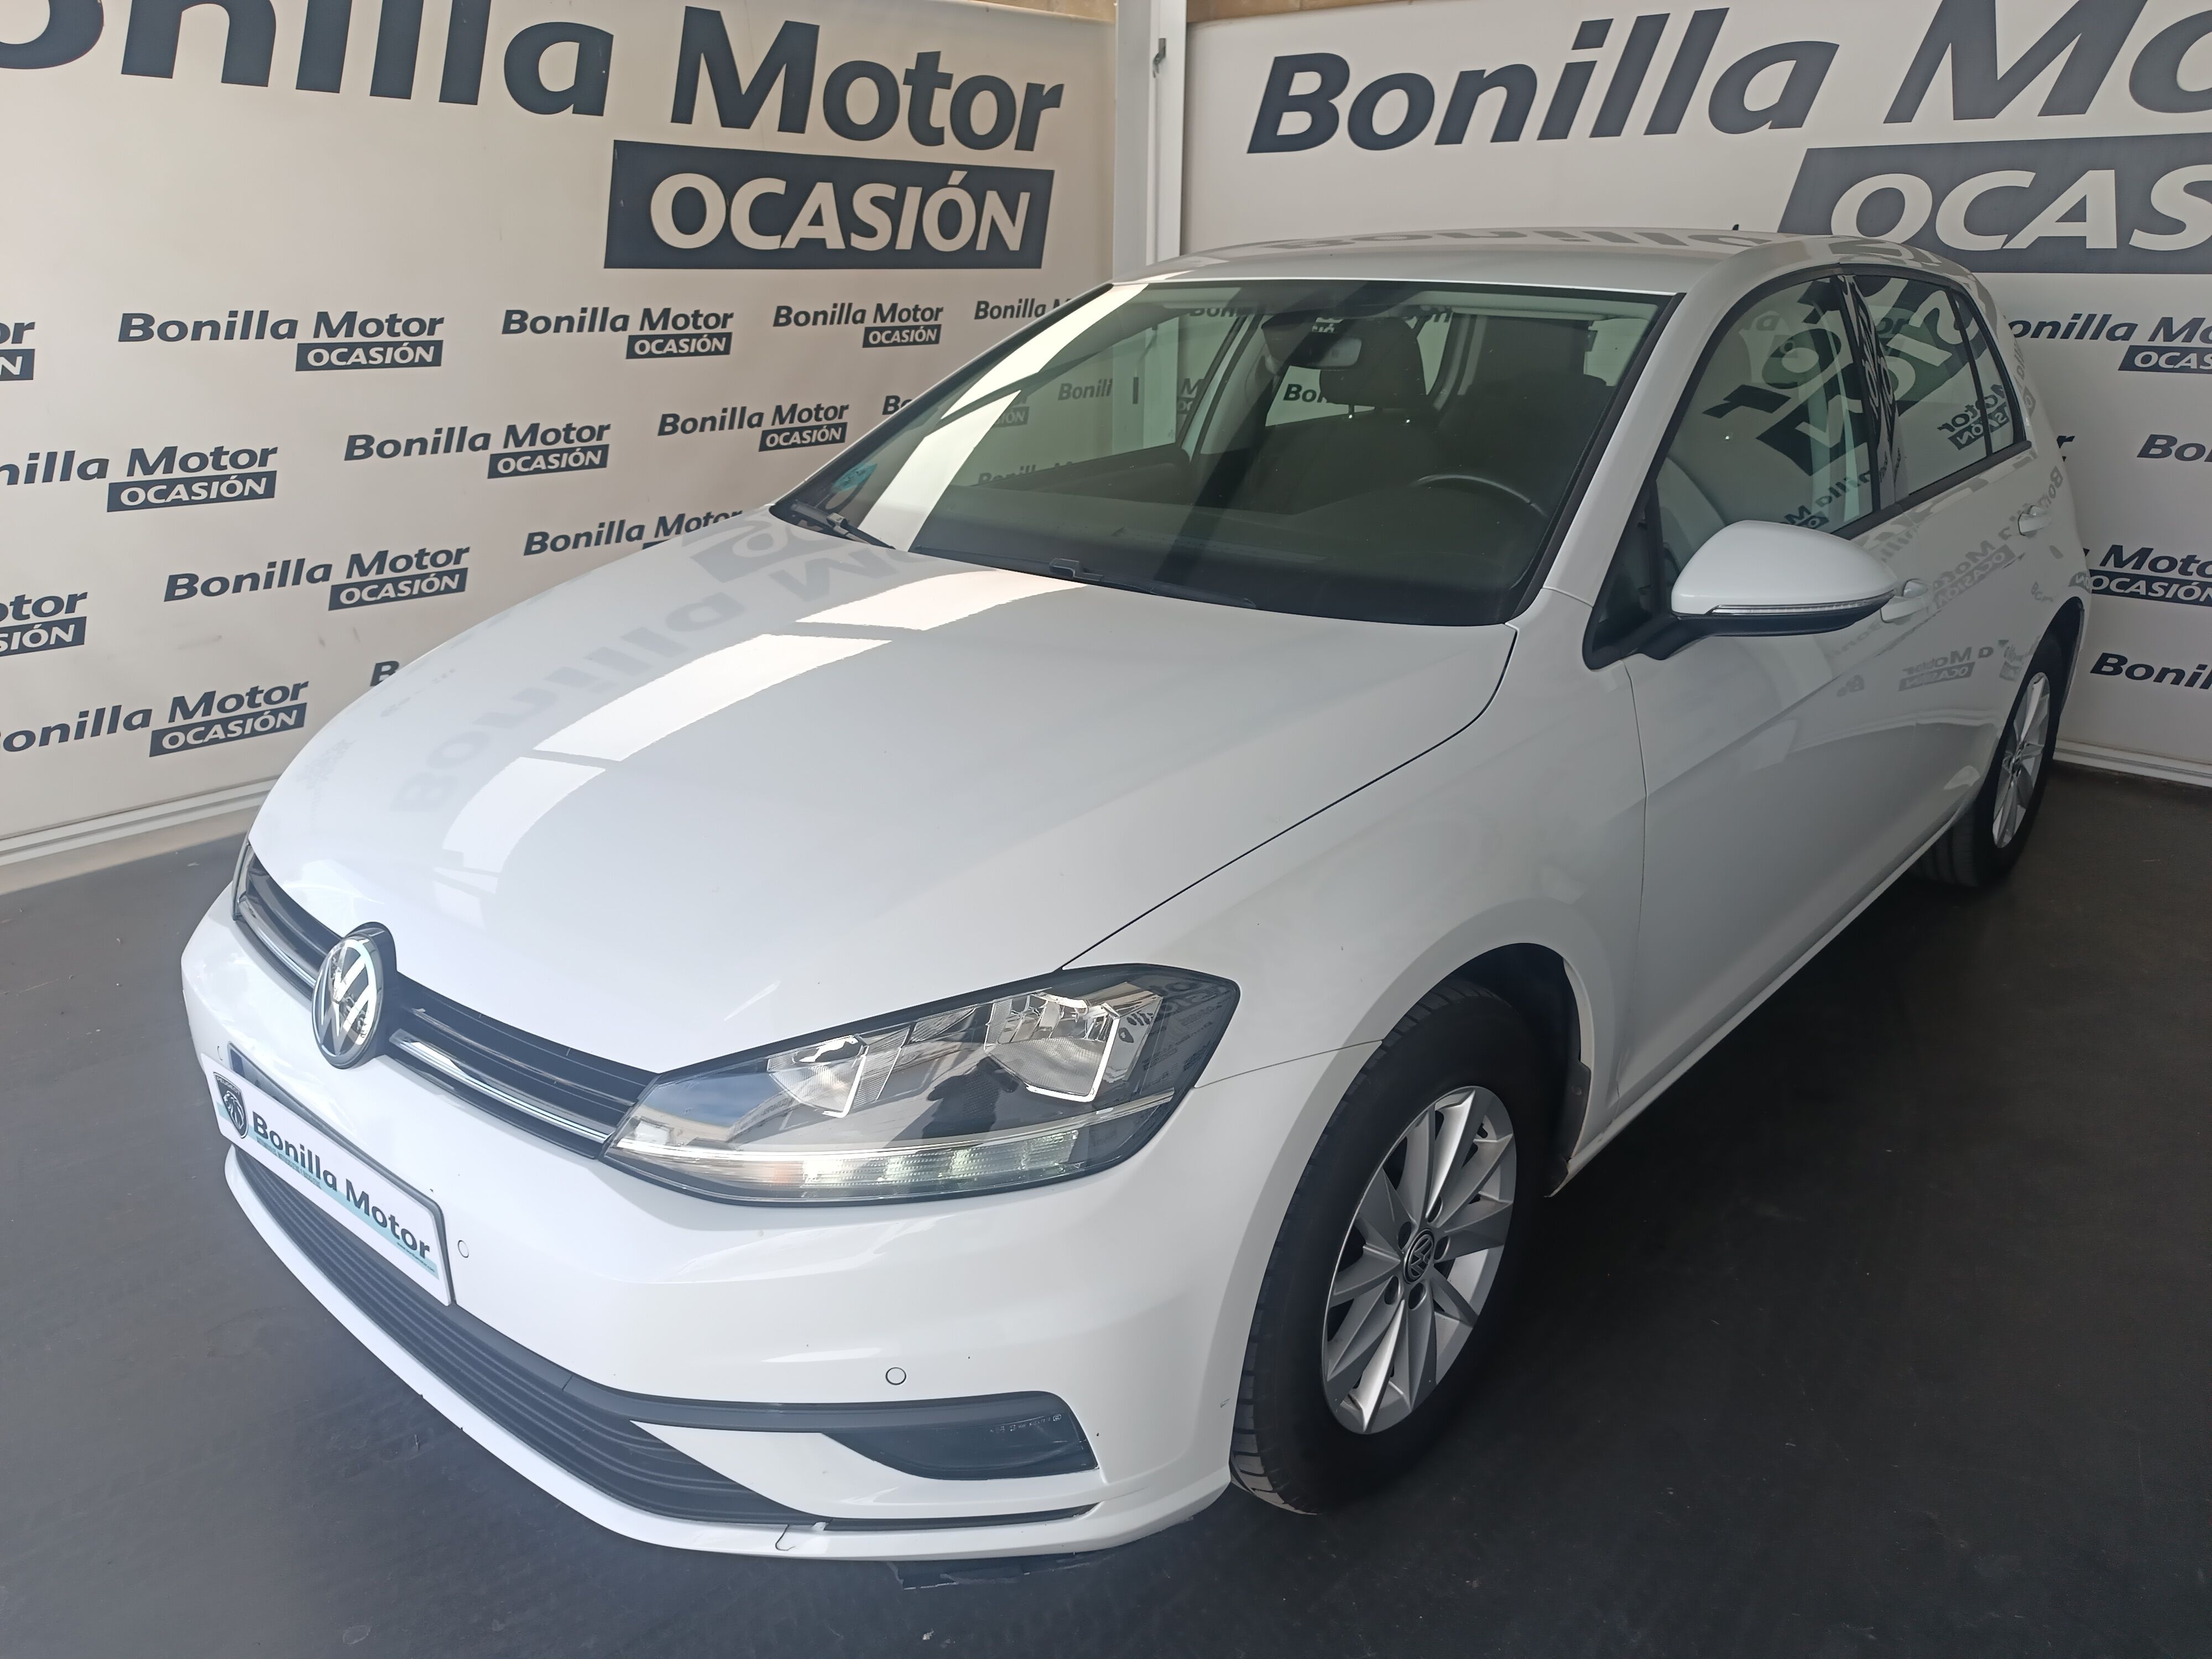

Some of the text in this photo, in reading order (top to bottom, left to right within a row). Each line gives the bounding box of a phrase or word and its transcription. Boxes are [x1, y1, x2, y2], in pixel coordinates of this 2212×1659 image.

[671, 6, 1064, 152] Motor
[1247, 8, 1839, 154] Bonilla
[651, 171, 1030, 252] OCASIÓN
[502, 307, 734, 334] Bonilla Motor
[773, 302, 943, 327] Bonilla Motor
[974, 299, 1046, 320] Bonilla
[118, 310, 444, 342] Bonilla Motor
[869, 326, 937, 344] OCASIÓN
[307, 342, 434, 366] OCASIÓN
[635, 335, 726, 354] OCASIÓN
[658, 404, 849, 436] Bonilla Motor
[345, 423, 611, 461] Bonilla Motor
[766, 426, 842, 447] OCASIÓN
[127, 446, 278, 477] Motor
[498, 448, 602, 473] OCASIÓN
[121, 475, 267, 505] OCASIÓN
[524, 519, 645, 556] Bonilla
[164, 547, 469, 602] Bonilla Motor
[340, 573, 459, 604] OCASIÓN
[0, 592, 87, 622] tor
[0, 681, 309, 752] onilla Motor
[163, 710, 297, 749] OCASIÓN
[253, 1111, 337, 1192] Bonilla
[346, 1179, 430, 1259] Motor
